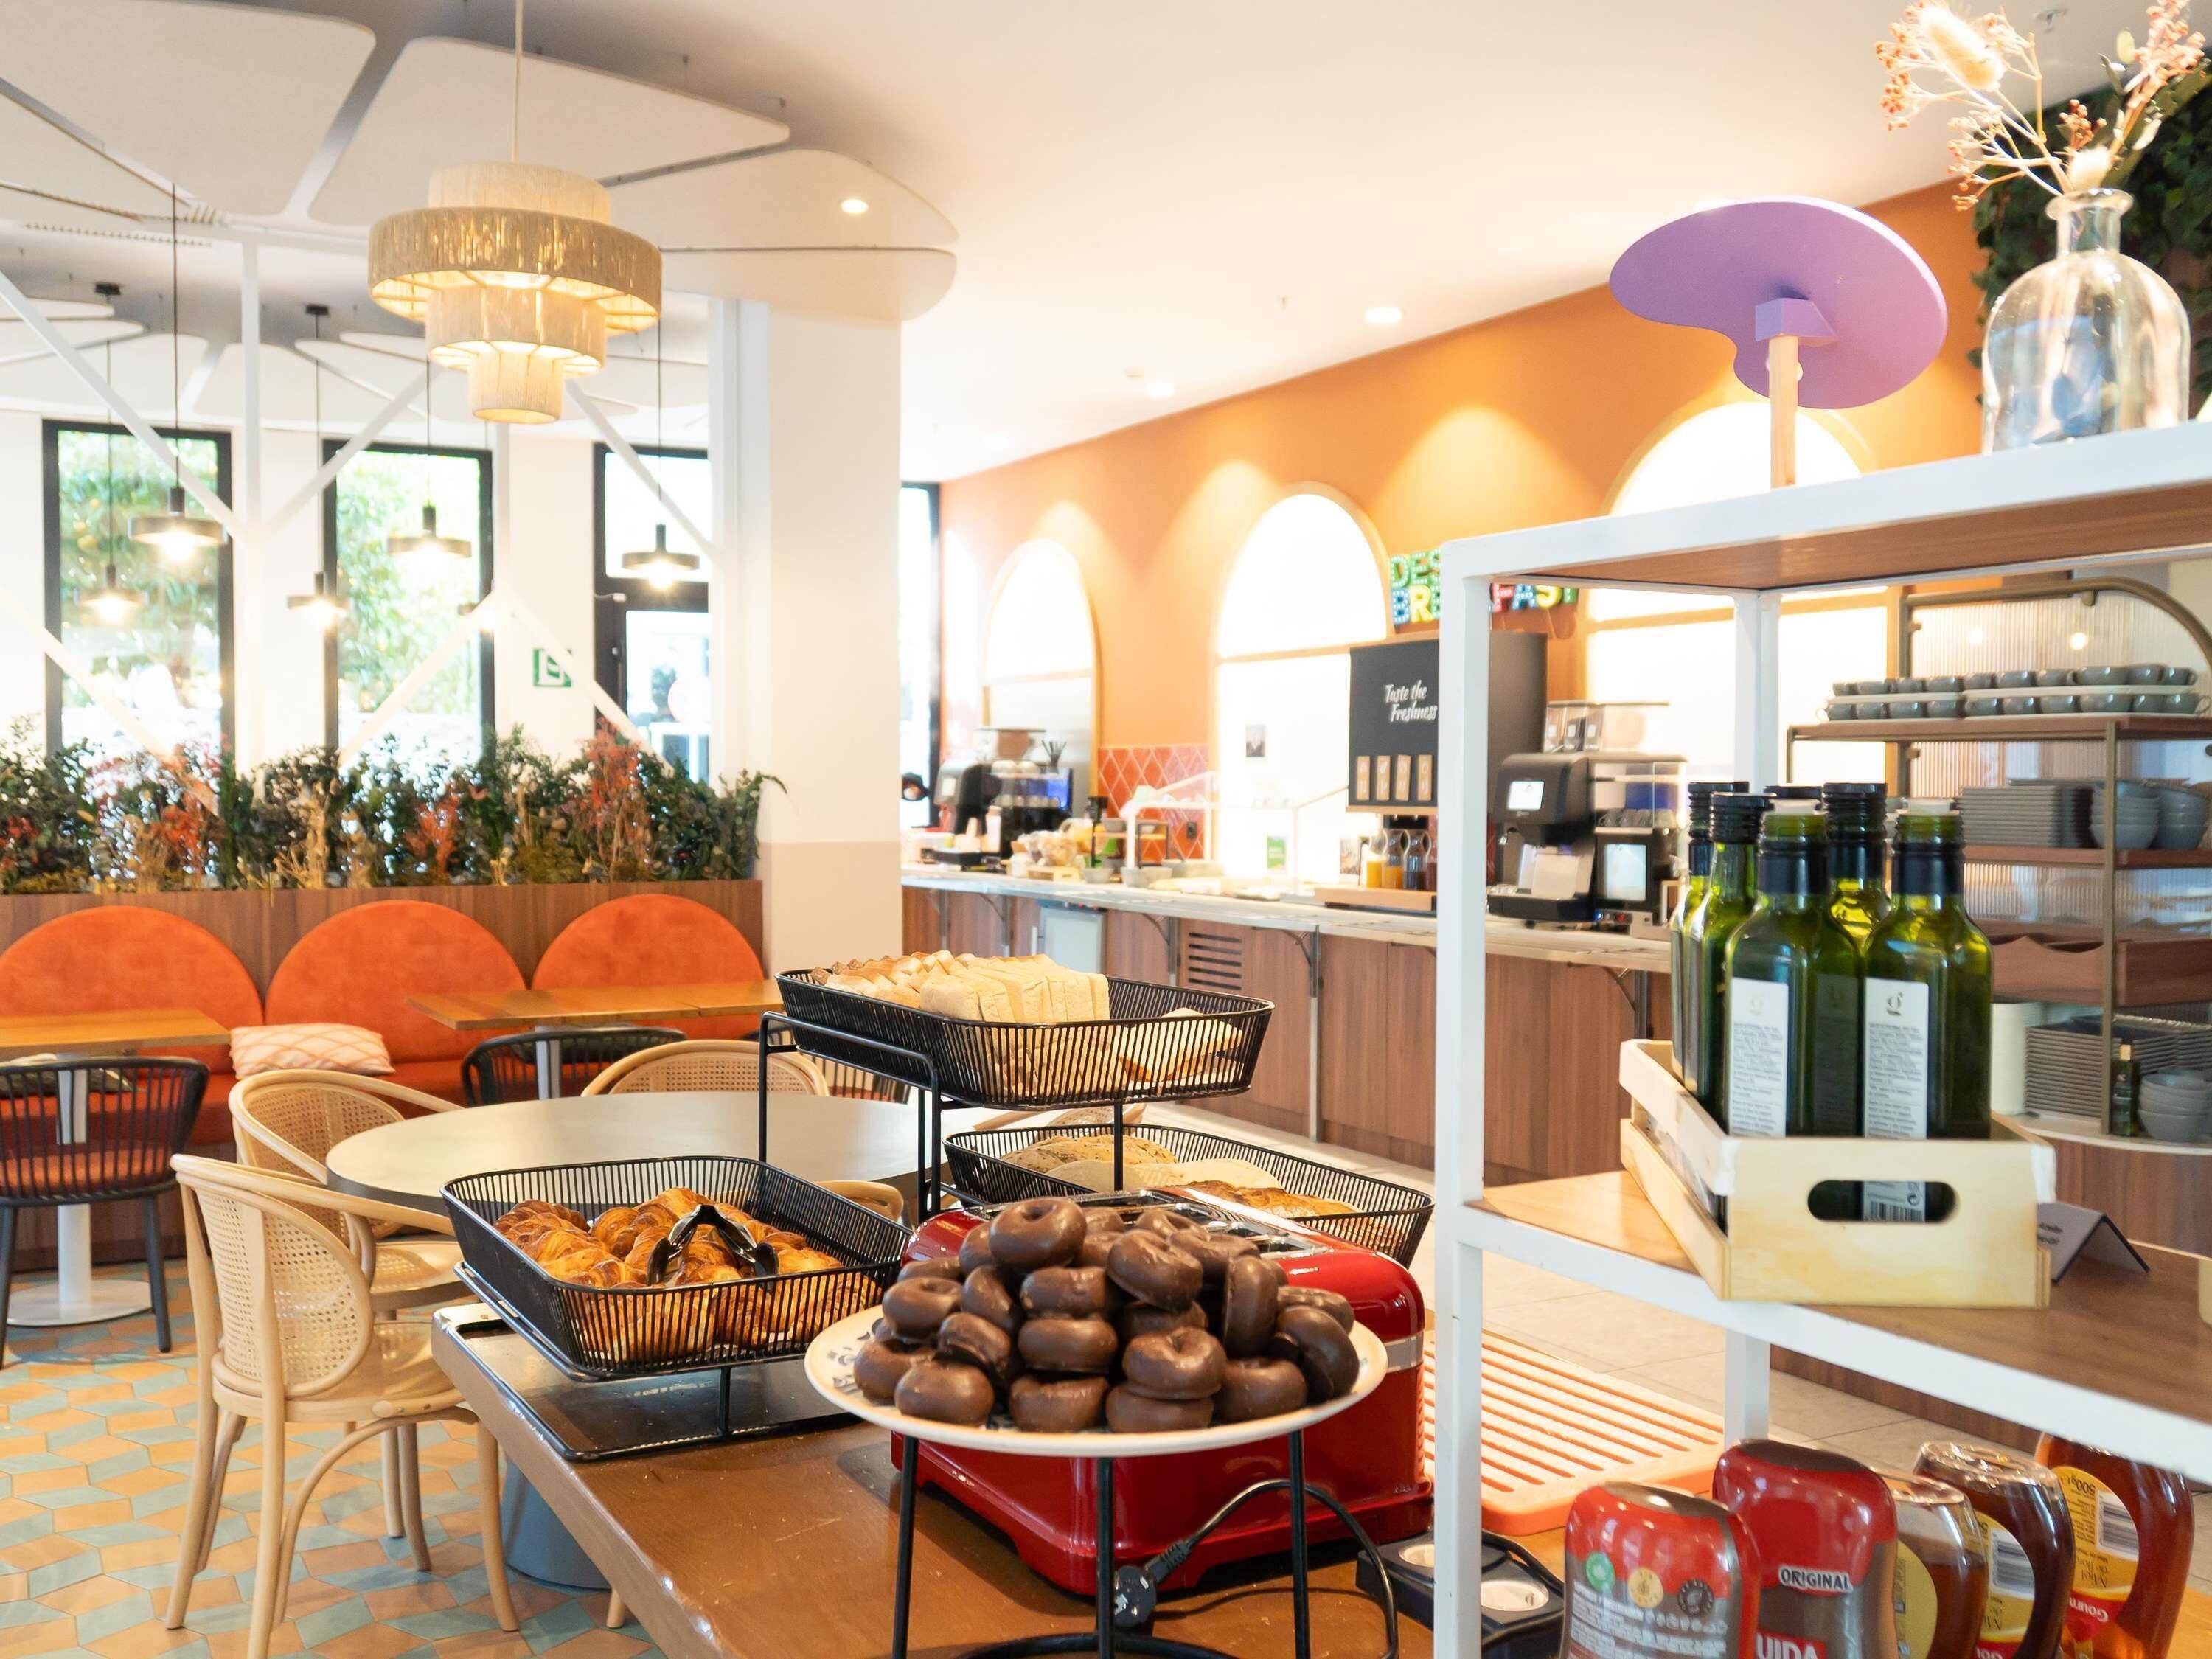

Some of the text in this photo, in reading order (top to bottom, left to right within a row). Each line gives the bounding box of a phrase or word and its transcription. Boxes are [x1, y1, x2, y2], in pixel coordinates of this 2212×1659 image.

[1385, 679, 1427, 703] Taste the
[1390, 700, 1439, 723] Freshness
[1781, 1568, 1849, 1590] ORIGINAL
